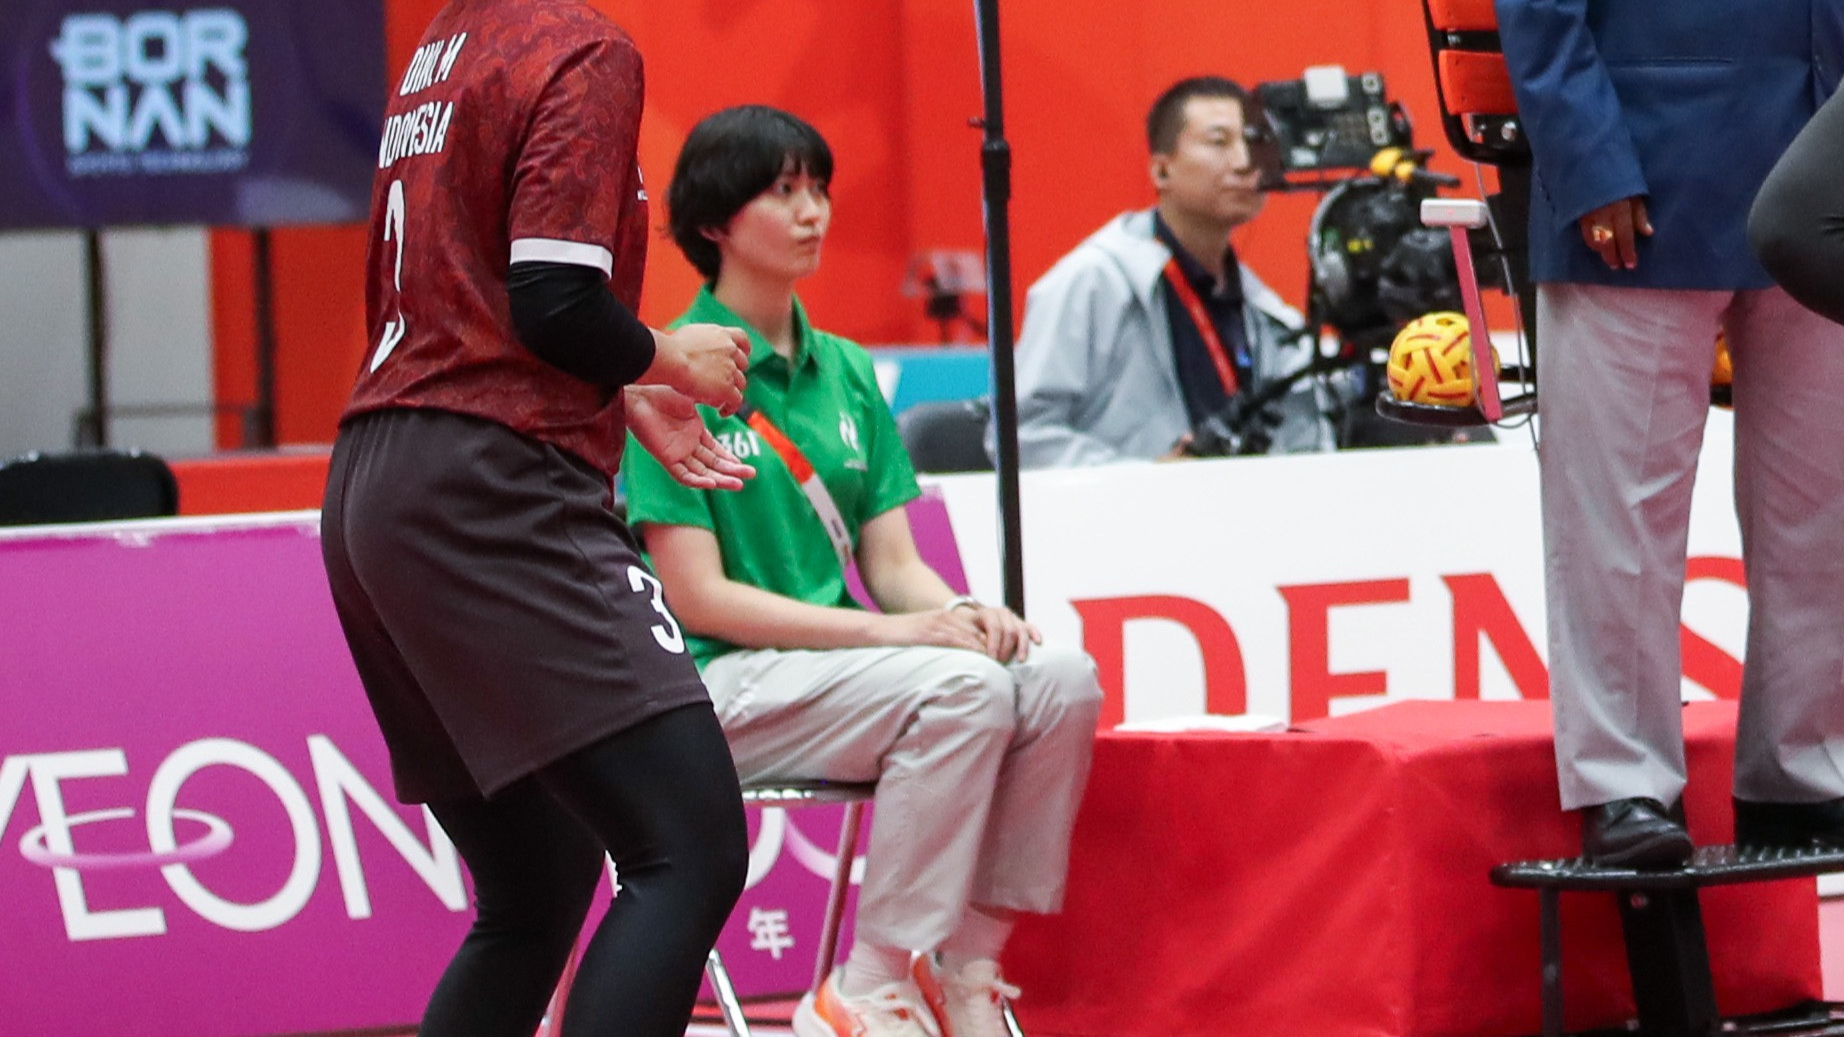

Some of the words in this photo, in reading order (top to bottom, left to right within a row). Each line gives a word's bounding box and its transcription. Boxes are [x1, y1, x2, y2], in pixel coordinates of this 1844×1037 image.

[50, 8, 248, 85] BOR
[63, 77, 252, 155] NAN
[627, 565, 685, 654] 3
